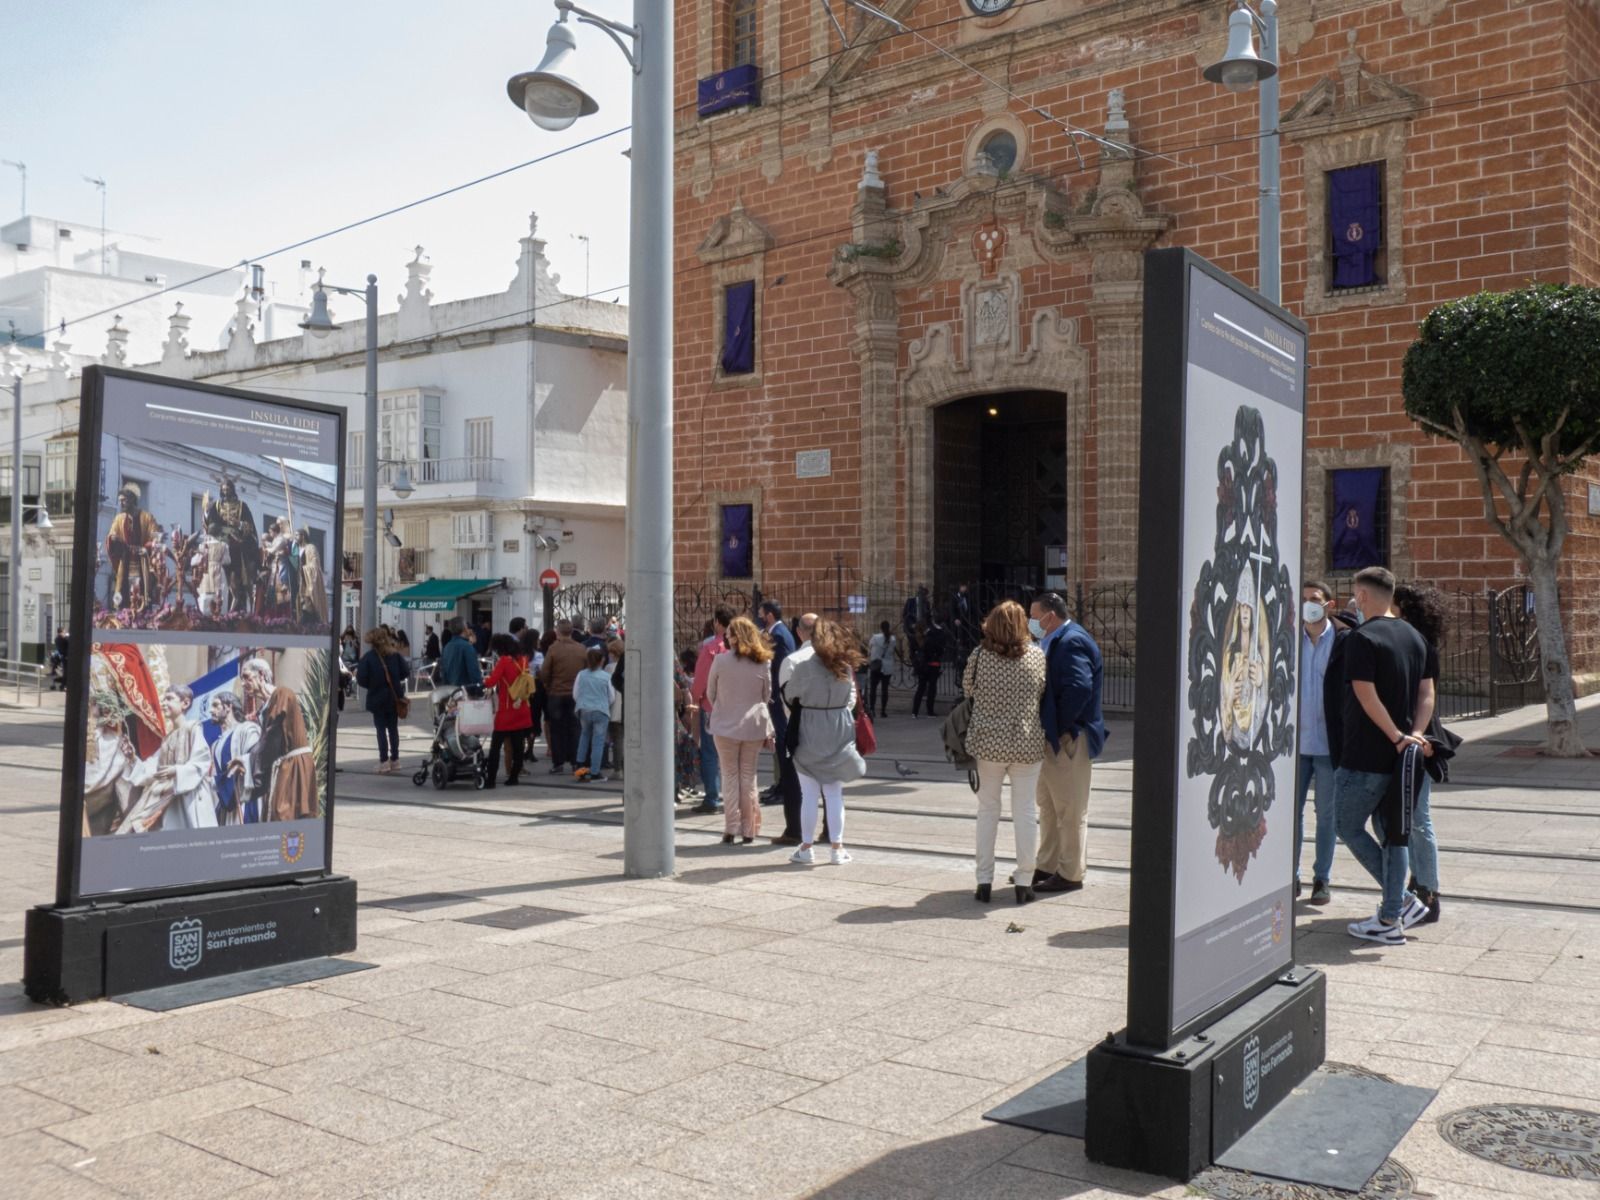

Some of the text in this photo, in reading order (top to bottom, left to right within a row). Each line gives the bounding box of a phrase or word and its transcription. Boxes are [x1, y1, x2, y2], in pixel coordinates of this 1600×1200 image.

[250, 409, 320, 430] INSULA FIDEI
[407, 600, 417, 609] LA
[174, 932, 198, 945] SAN
[206, 930, 277, 950] San Fernando
[207, 921, 277, 940] Ayuntamiento de
